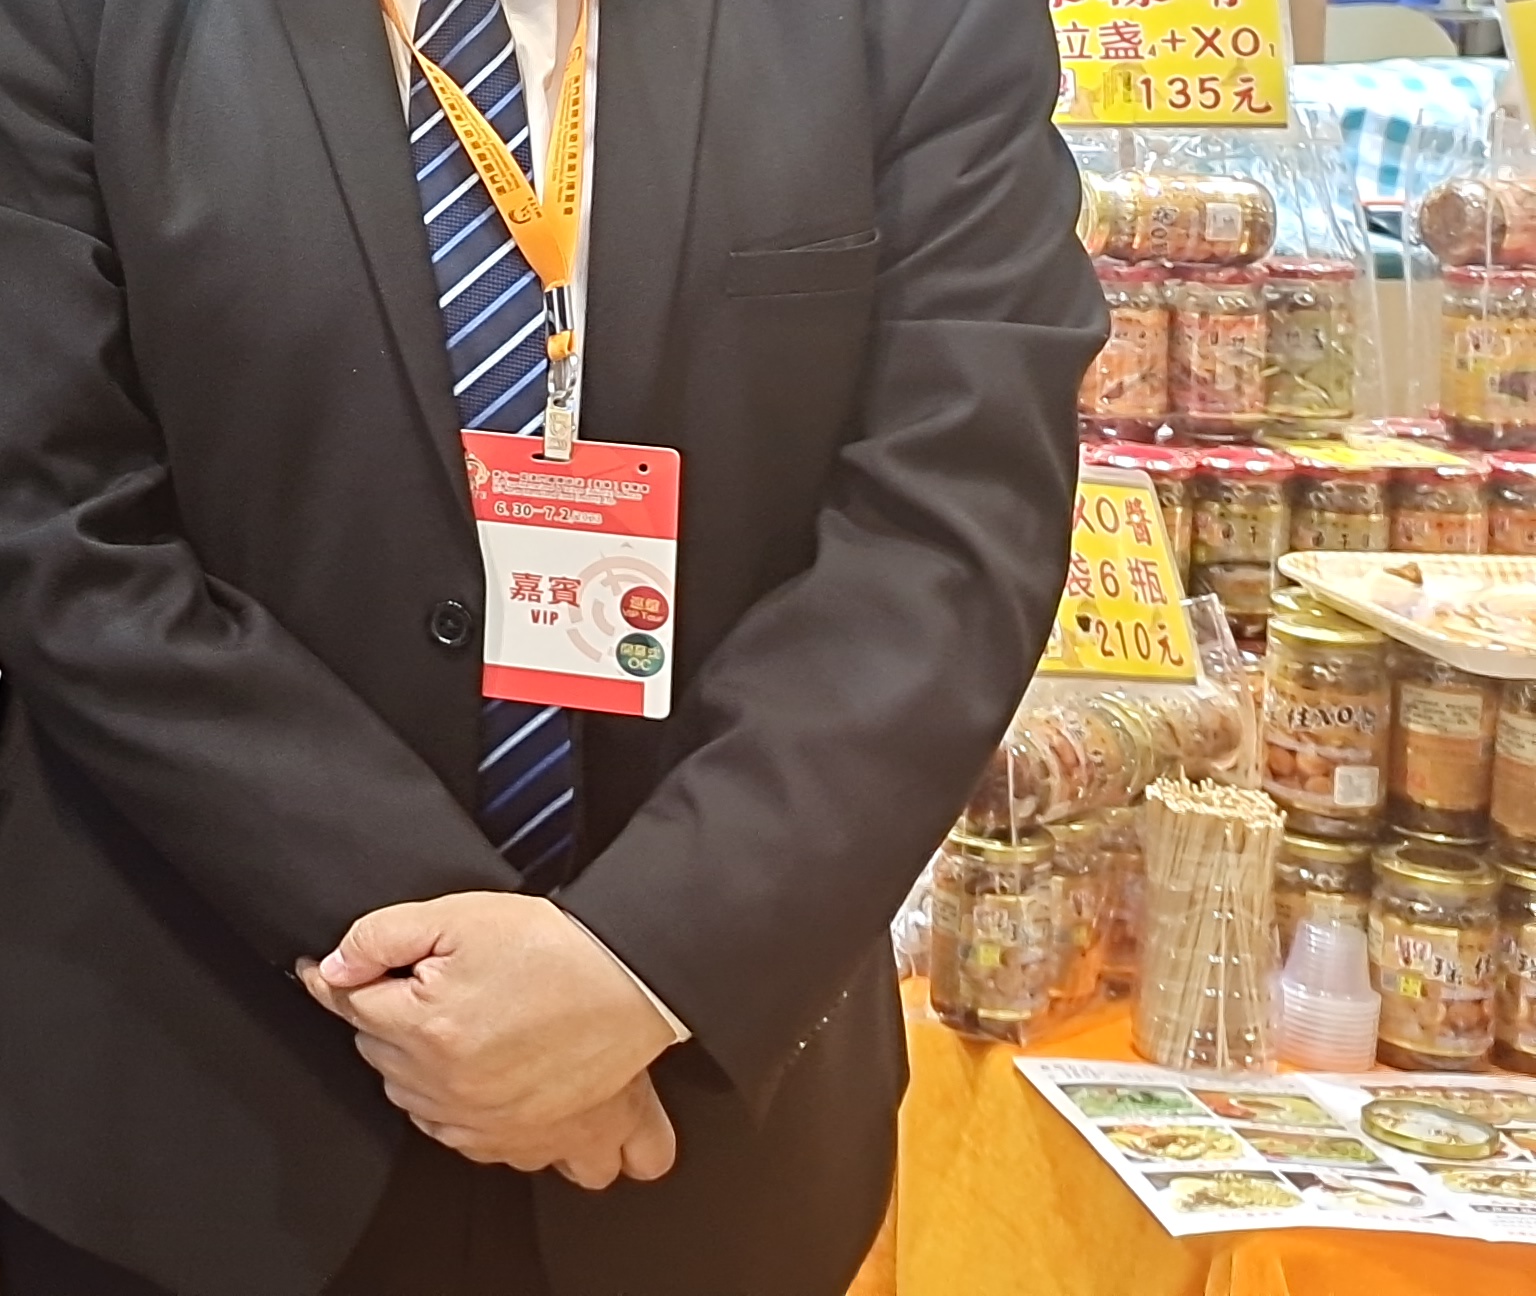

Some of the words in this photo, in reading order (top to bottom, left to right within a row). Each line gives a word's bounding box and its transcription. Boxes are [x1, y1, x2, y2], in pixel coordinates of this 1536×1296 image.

[1139, 75, 1273, 114] 135元
[509, 572, 583, 607] 嘉賓
[530, 609, 559, 626] VIP
